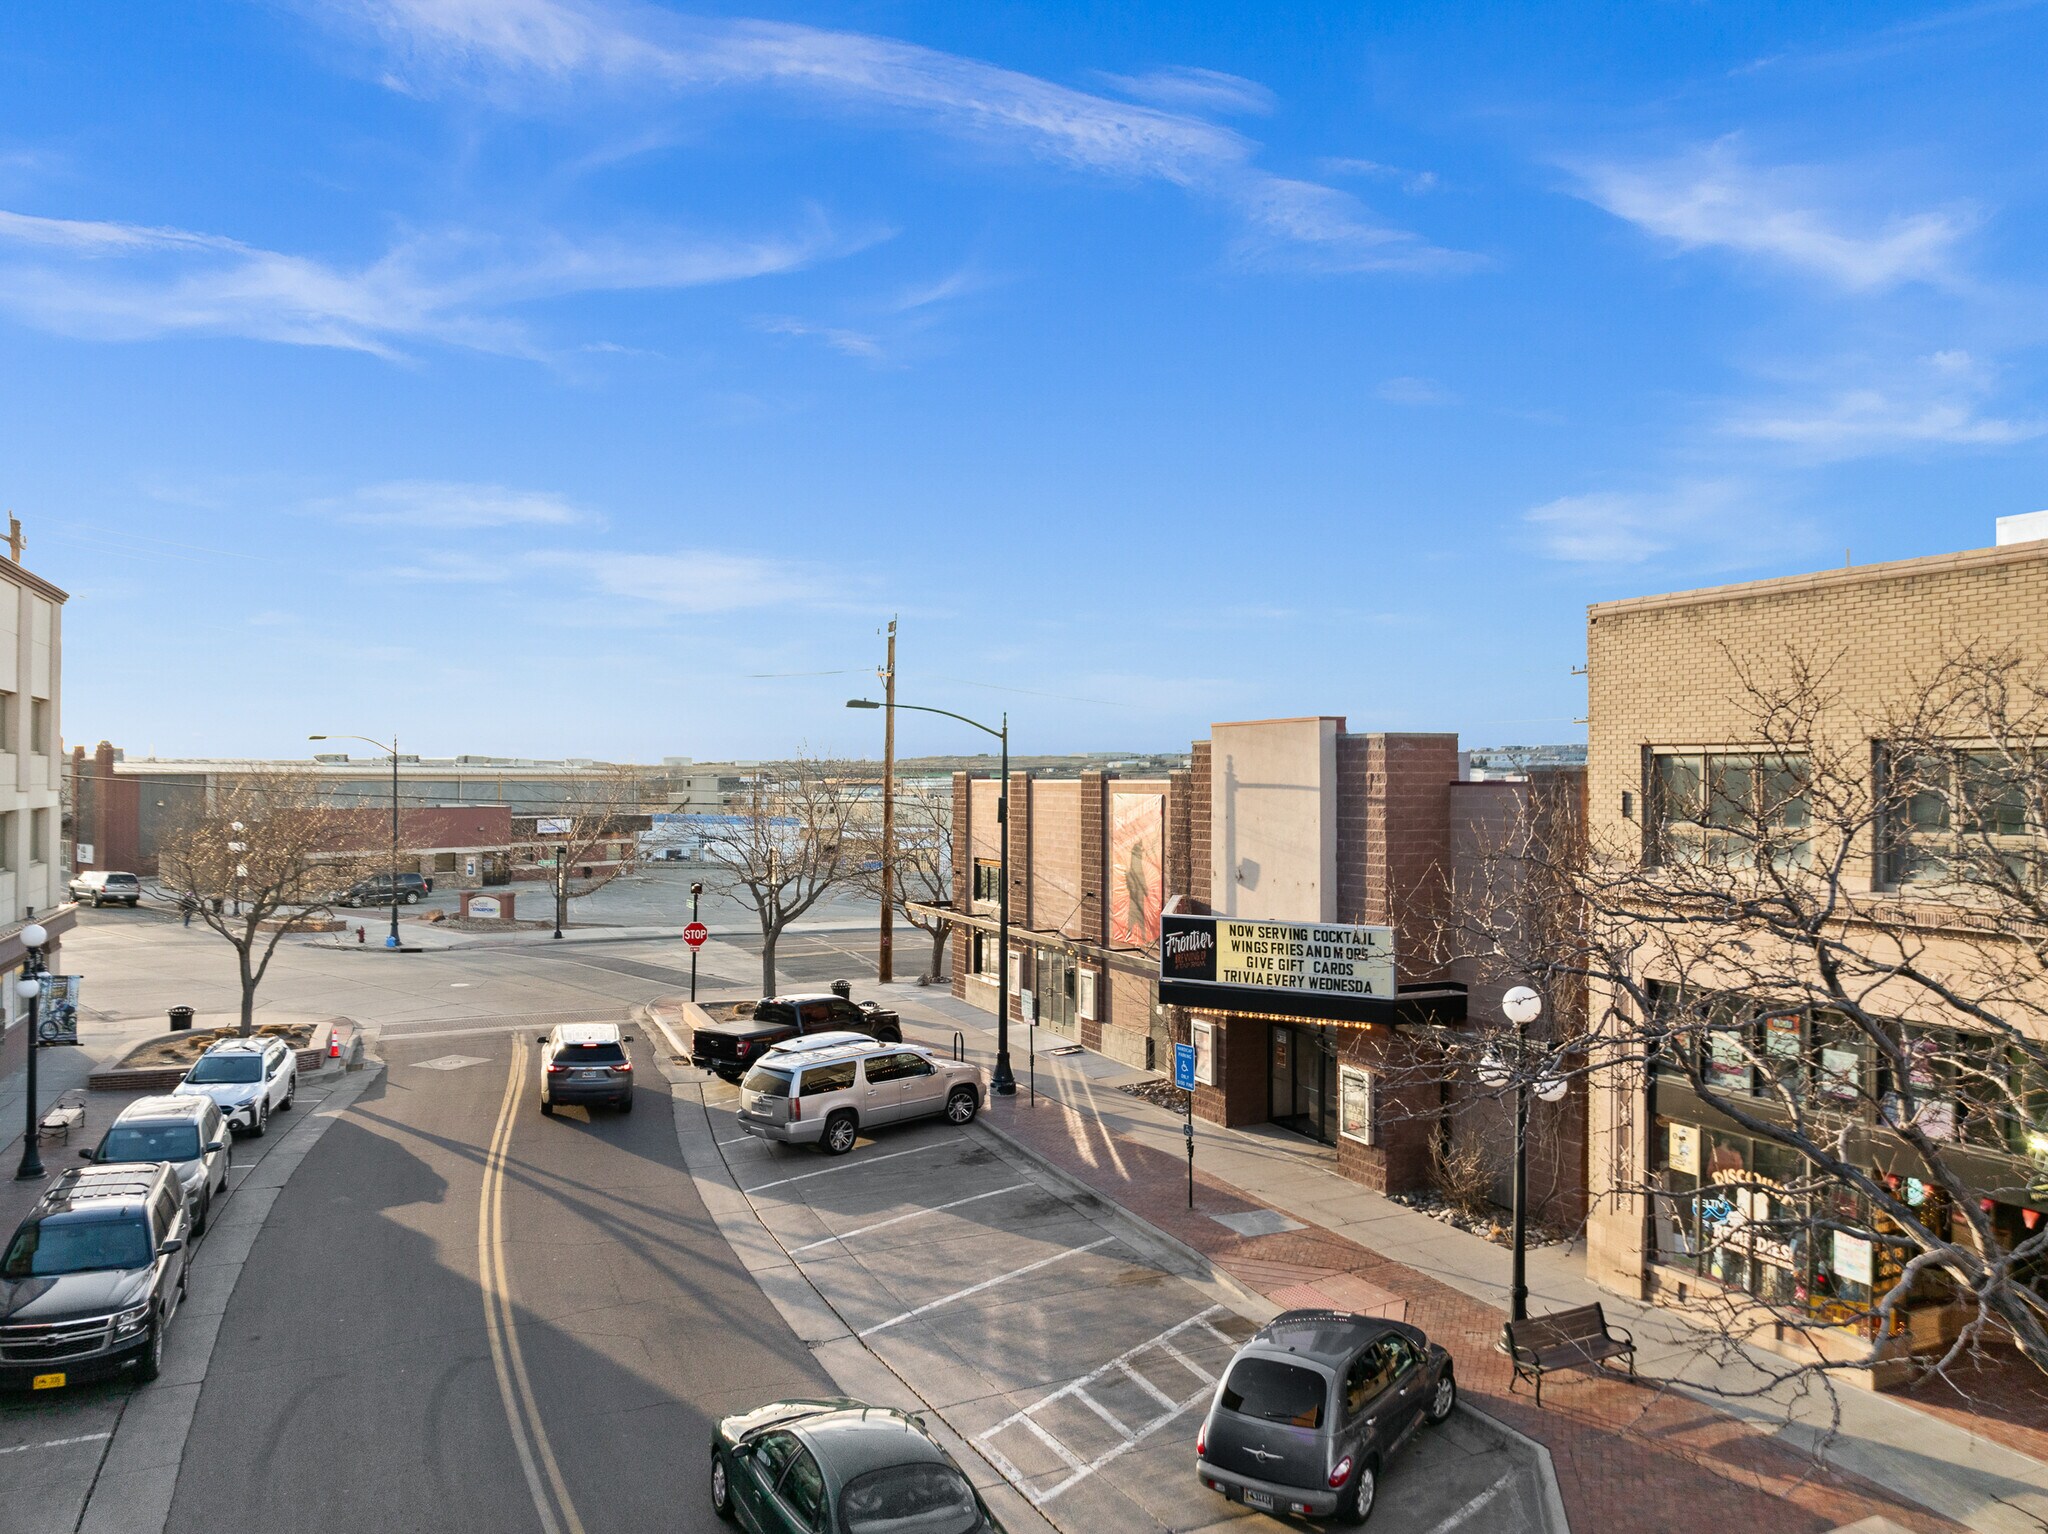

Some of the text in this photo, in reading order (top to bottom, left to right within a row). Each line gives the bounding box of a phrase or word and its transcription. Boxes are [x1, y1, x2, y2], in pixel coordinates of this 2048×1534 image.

[684, 929, 707, 940] STOP
[1165, 930, 1214, 957] Frontier
[1229, 924, 1375, 946] NOW SERVING COCKTAIL
[1231, 940, 1268, 954] WINGS
[1270, 942, 1303, 957] FRIES
[1306, 945, 1331, 959] AND
[1246, 956, 1354, 976] GIVE GIFT CARDS
[1224, 970, 1373, 994] TRIVIA EVERY WEDNESDA
